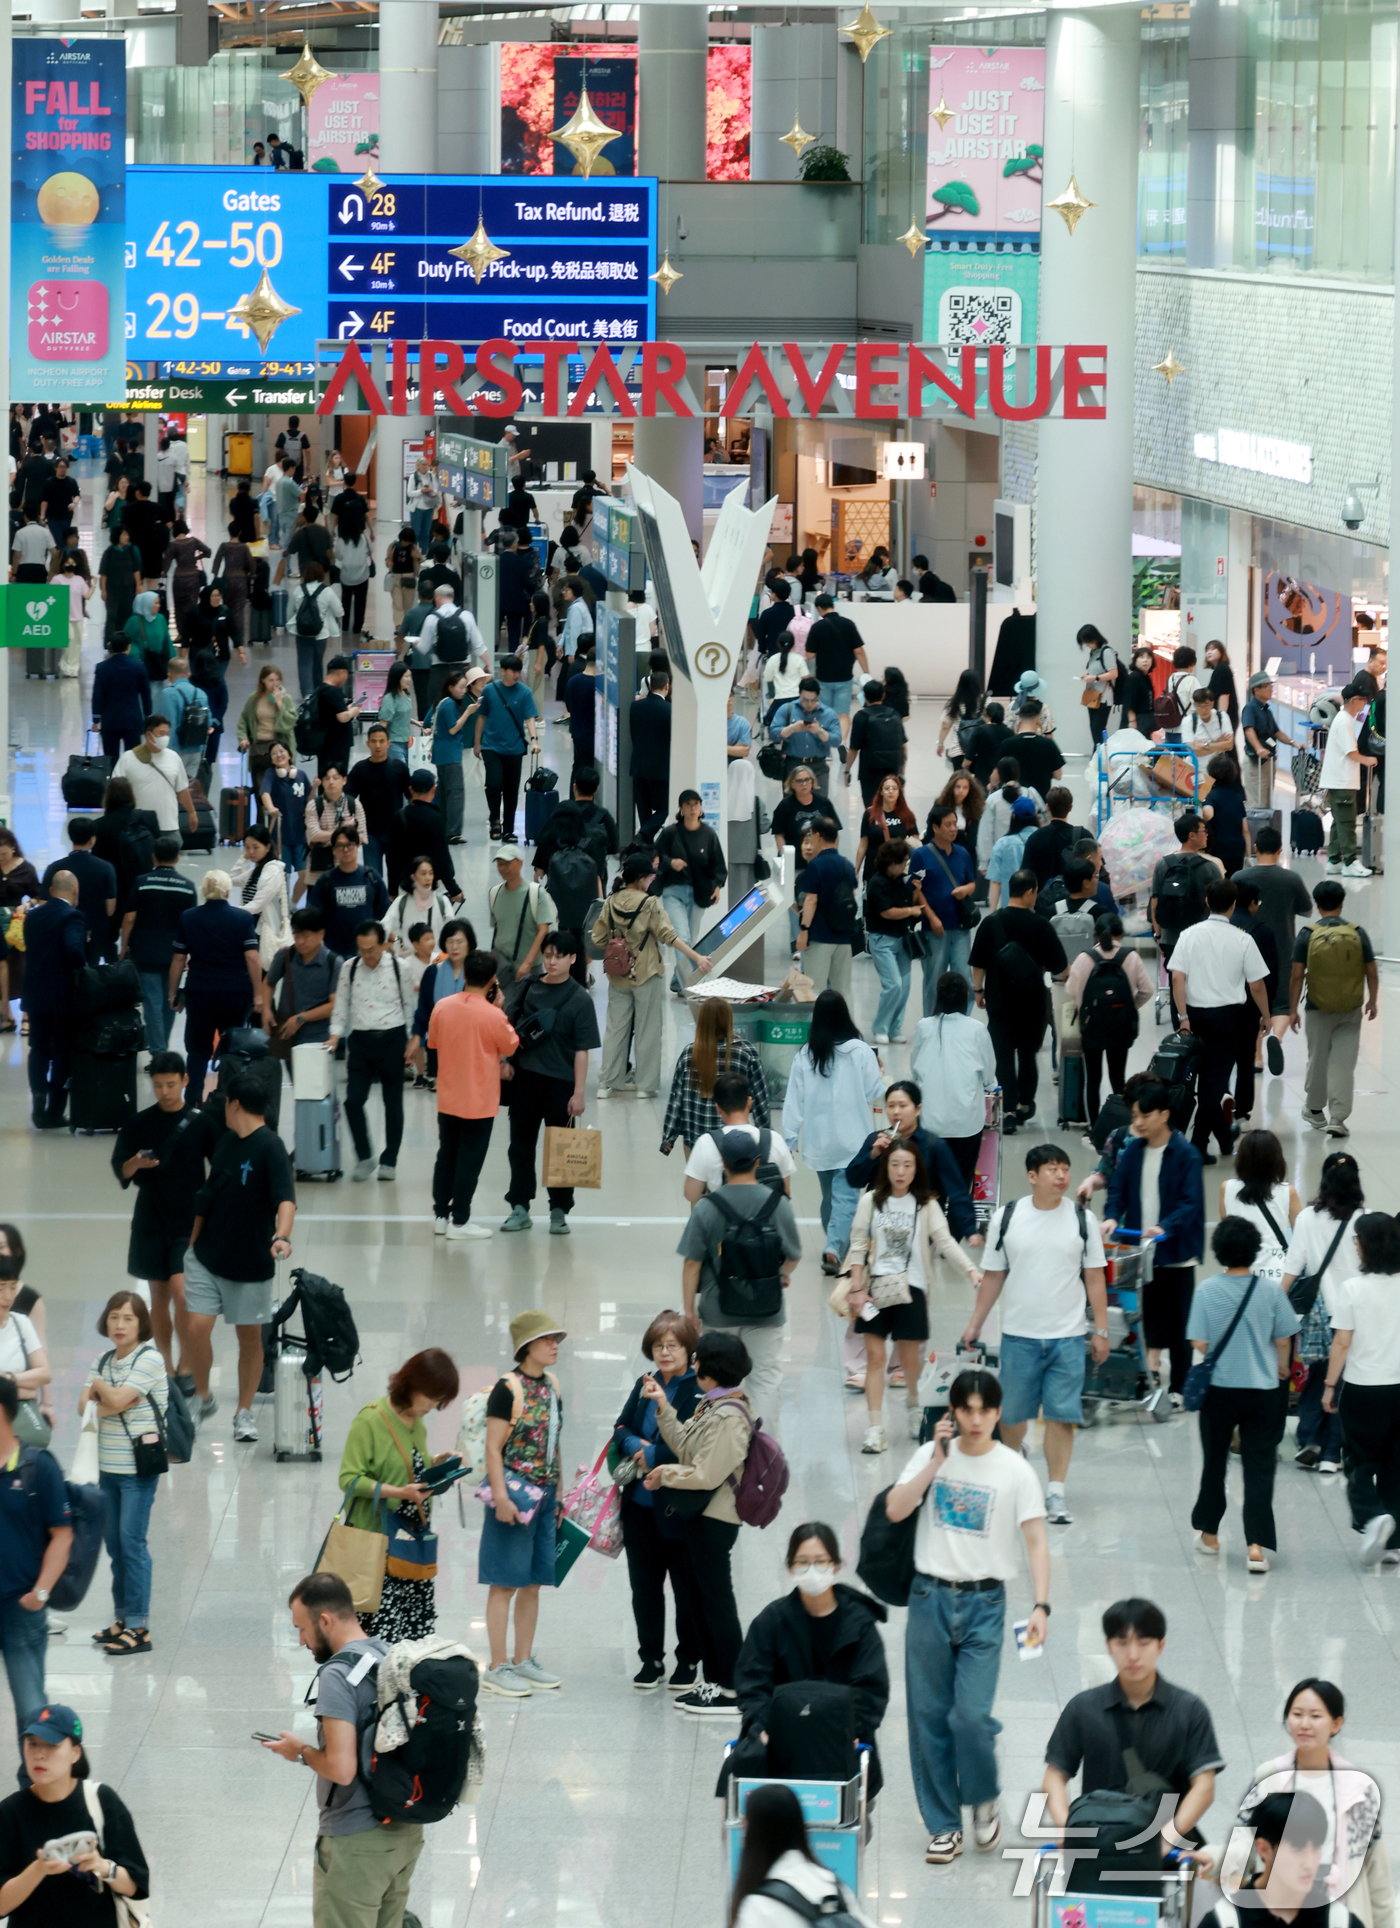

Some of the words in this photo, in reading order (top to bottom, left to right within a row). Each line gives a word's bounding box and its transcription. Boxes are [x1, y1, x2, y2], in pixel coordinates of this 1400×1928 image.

[58, 52, 92, 60] AIRSTAR
[25, 80, 112, 116] FALL
[961, 89, 1013, 111] JUST
[328, 100, 360, 114] JUST
[58, 116, 79, 131] for
[324, 115, 349, 129] USE
[351, 115, 363, 129] IT
[955, 113, 994, 135] USE
[999, 114, 1019, 136] IT
[25, 131, 112, 151] SHOPPING
[318, 129, 369, 144] AIRSTAR
[944, 137, 1027, 160] AIRSTAR
[223, 189, 281, 212] Gates
[371, 193, 396, 217] 28
[514, 202, 543, 221] Tax
[545, 201, 606, 222] Refund,
[609, 203, 640, 223] 退税
[371, 221, 388, 231] 90m
[146, 220, 283, 268] 42-50
[42, 255, 71, 264] Golden
[72, 255, 95, 264] Deals
[370, 252, 396, 275] 4F
[950, 262, 973, 270] Smart
[974, 263, 1014, 272] Duty-Free
[47, 265, 60, 273] are
[62, 265, 90, 275] Falling
[417, 260, 453, 282] Duty
[489, 260, 549, 283] Pick-up,
[551, 261, 639, 280] 免税品领取处
[963, 271, 1000, 281] Shopping
[371, 280, 388, 290] 10m
[146, 292, 274, 339] 29-4
[370, 310, 395, 333] 4F
[503, 318, 542, 337] Food
[544, 319, 591, 338] Court,
[592, 319, 638, 338] 美食街
[40, 331, 97, 345] AIRSTAR
[27, 368, 69, 377] INCHEON
[70, 368, 109, 377] AIRPORT
[175, 361, 221, 375] 42-50
[227, 366, 250, 376] Gates
[259, 361, 302, 376] 29-41
[85, 378, 104, 387] APP
[316, 338, 695, 418] AIRSTAR
[719, 339, 1108, 421] AVENUE
[125, 385, 166, 399] ansfer
[169, 385, 203, 400] Desk
[252, 388, 305, 405] Transfer
[131, 400, 163, 410] Airlines
[22, 624, 52, 636] AED
